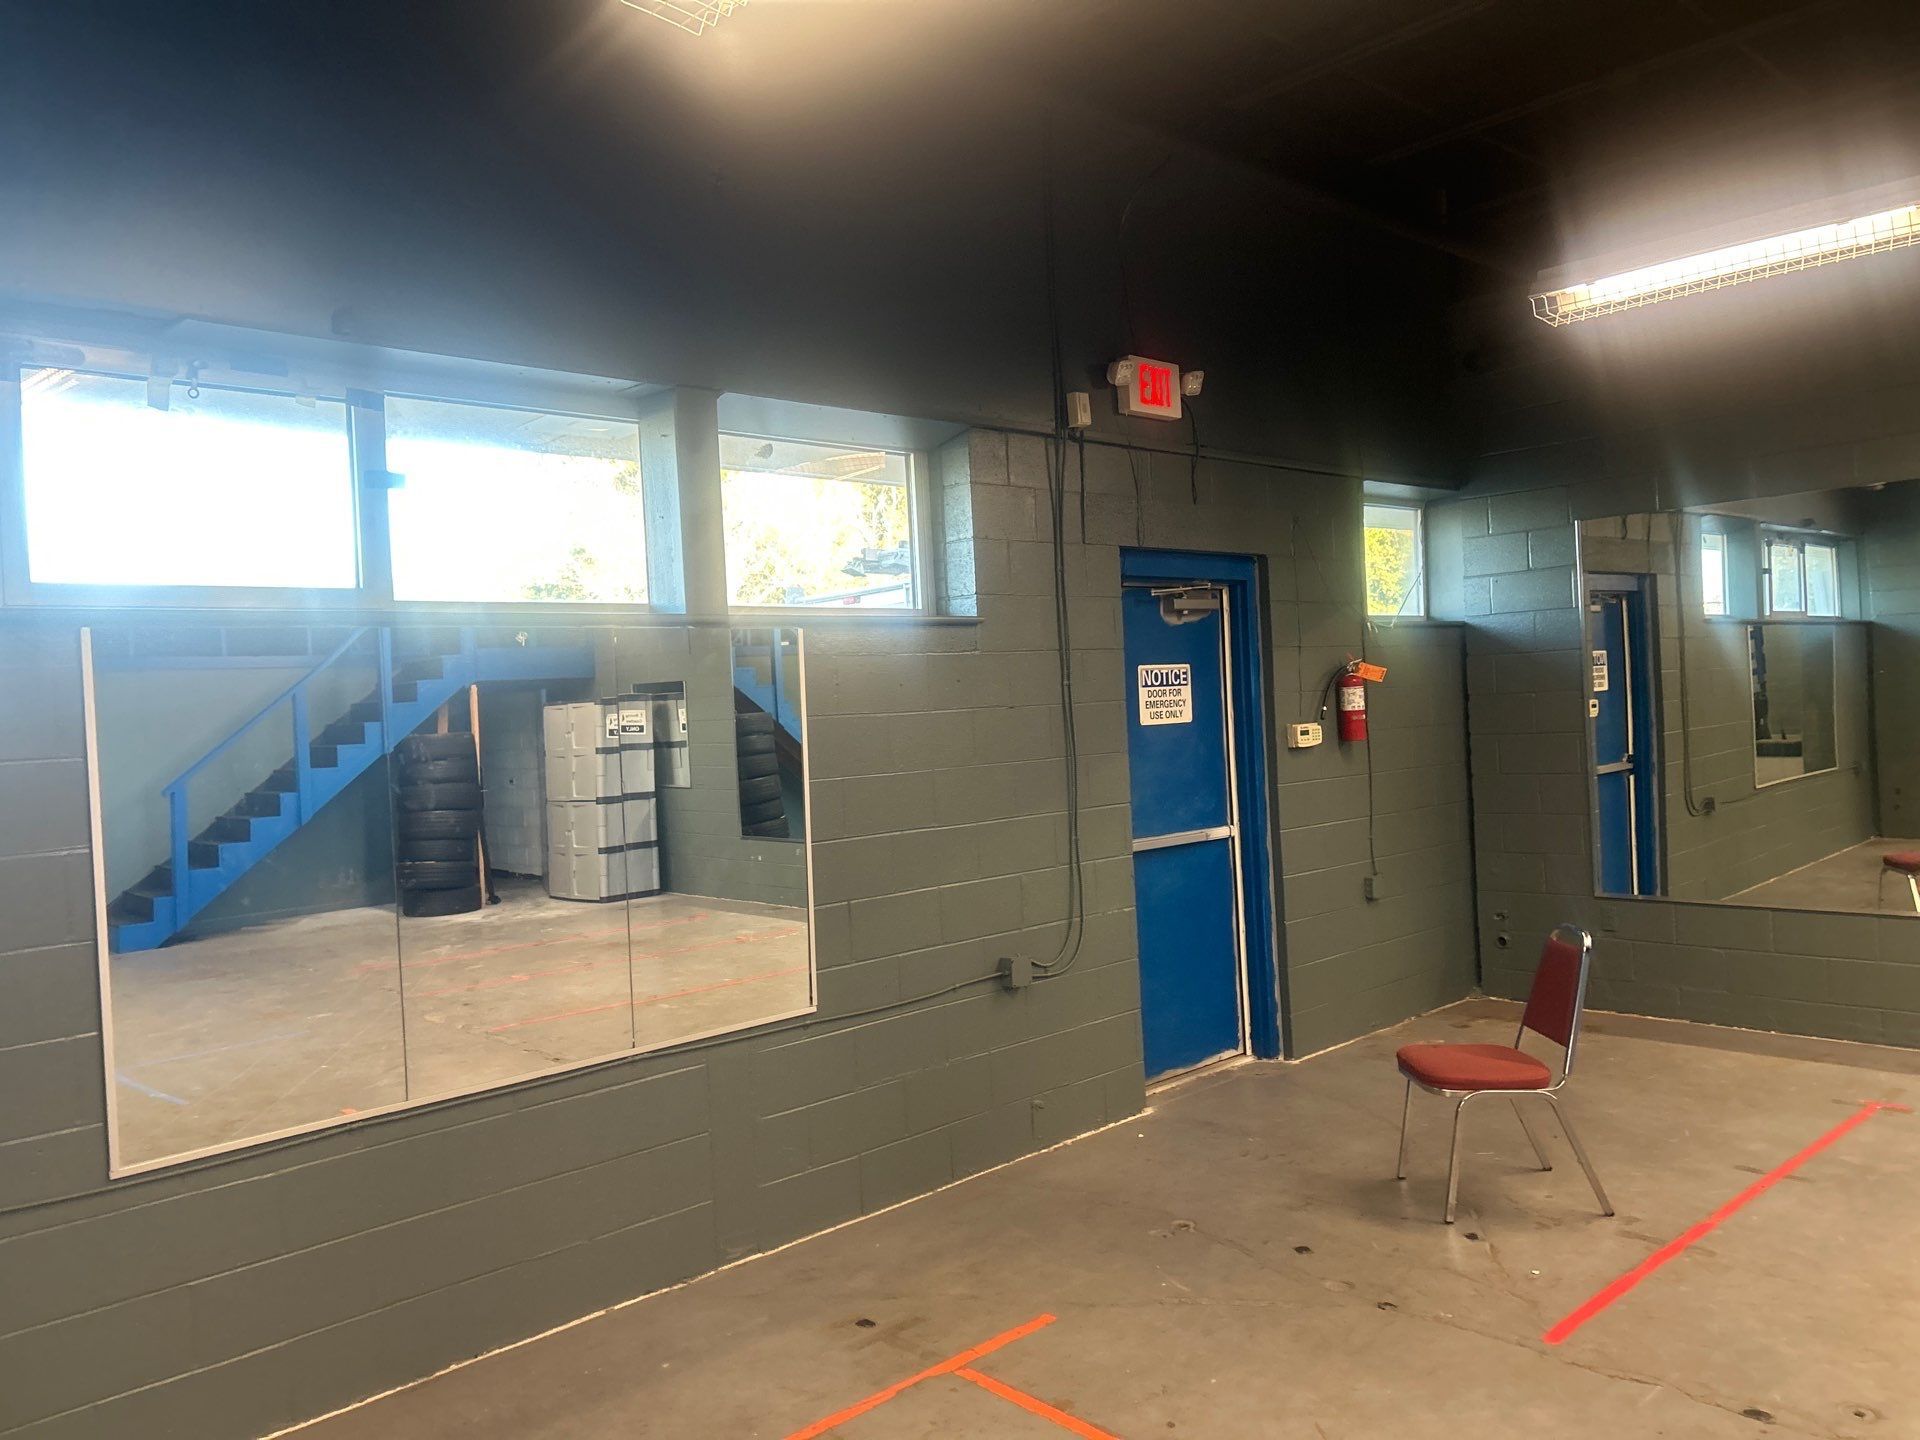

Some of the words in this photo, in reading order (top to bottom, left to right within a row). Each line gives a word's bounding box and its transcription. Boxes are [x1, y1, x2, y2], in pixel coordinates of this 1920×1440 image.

[1139, 363, 1171, 407] EXIT
[1141, 669, 1188, 686] NOTICE
[1147, 689, 1167, 698] DOOR
[1168, 688, 1182, 697] FOR
[1145, 699, 1186, 709] EMERGENCY
[1149, 711, 1164, 719] USE
[1165, 710, 1183, 718] ONLY
